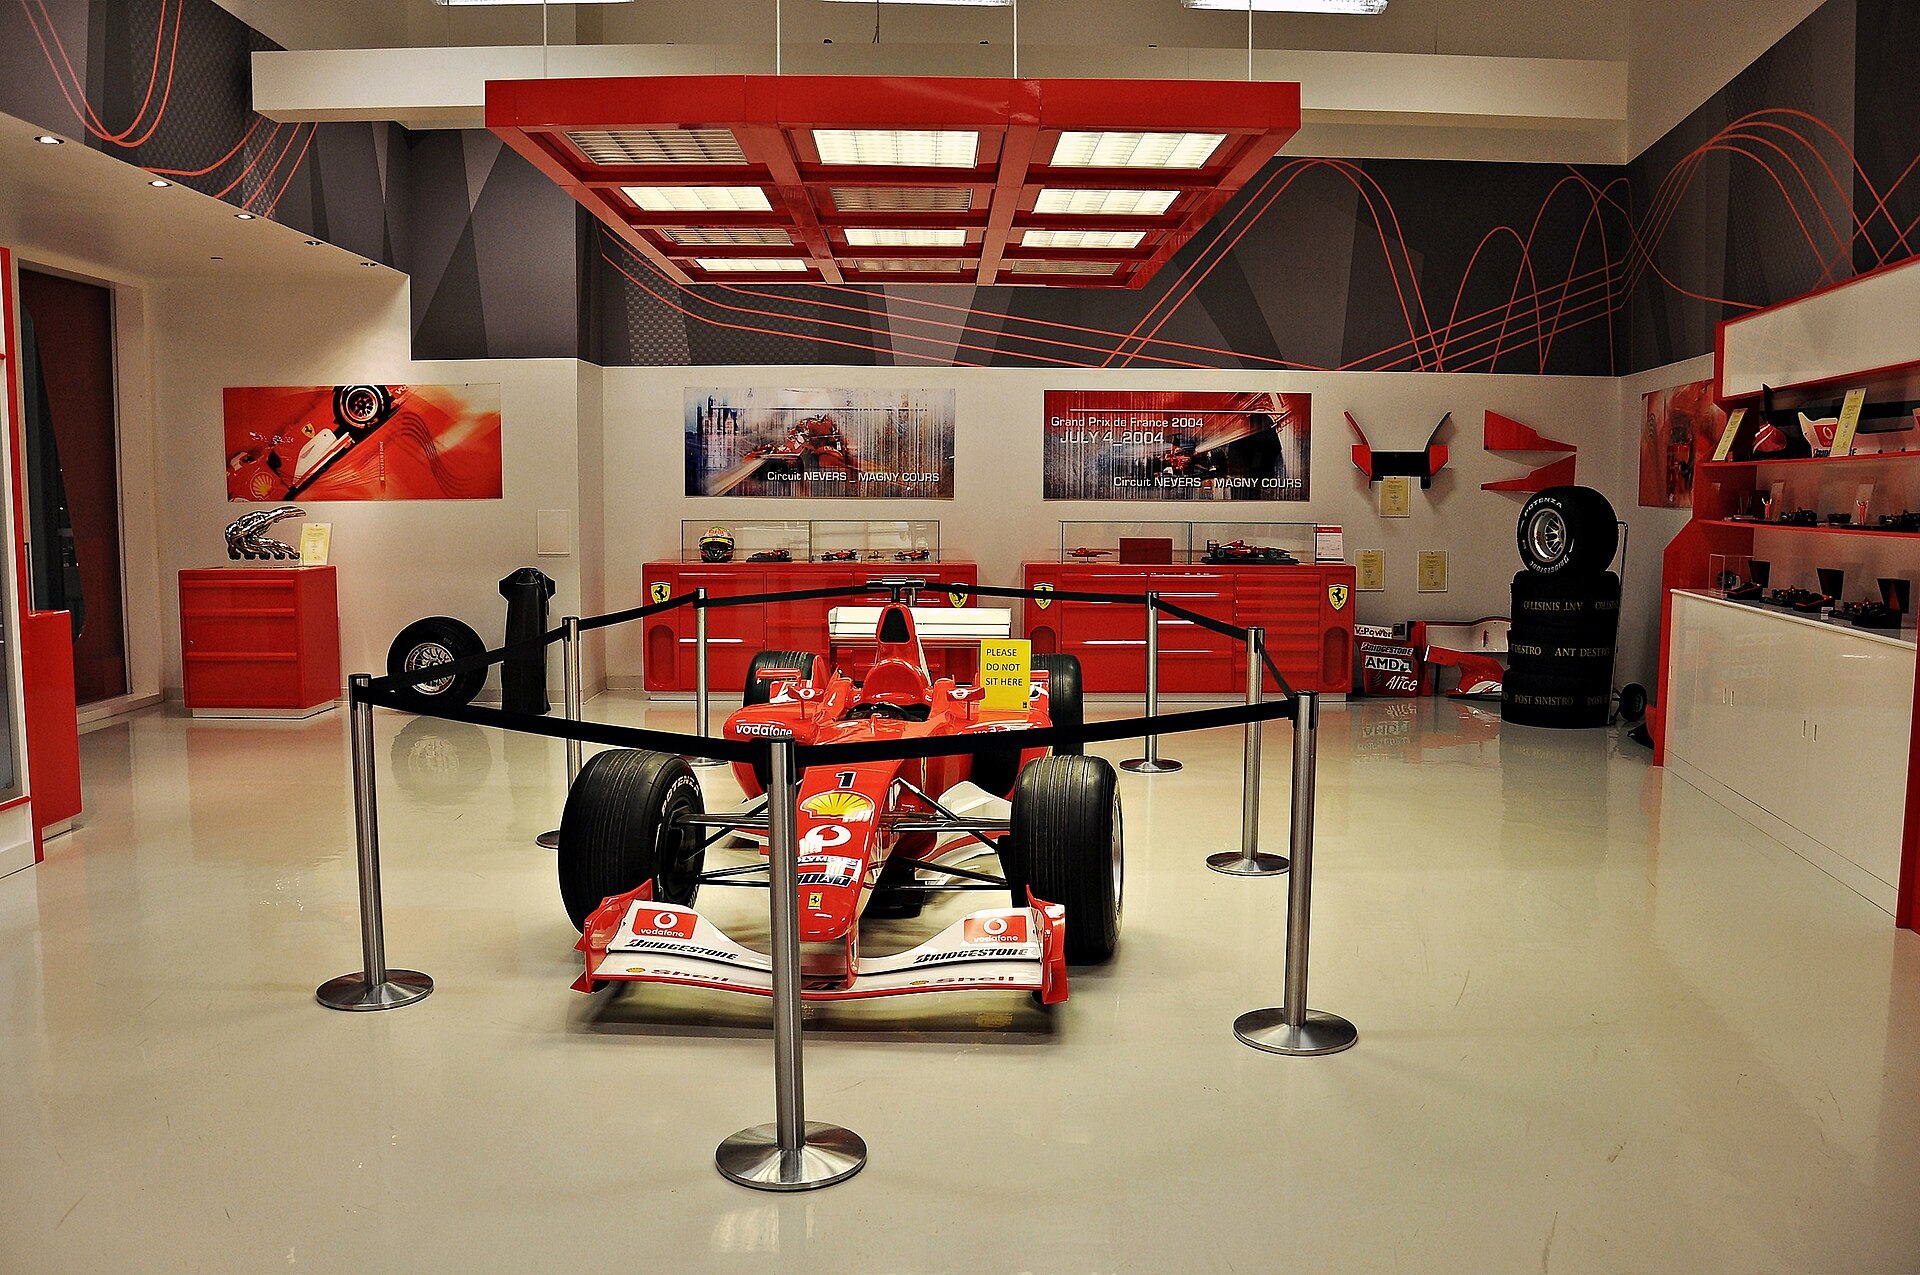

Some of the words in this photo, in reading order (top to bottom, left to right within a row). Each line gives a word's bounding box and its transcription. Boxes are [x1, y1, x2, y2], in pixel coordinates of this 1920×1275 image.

[1051, 416, 1085, 427] Grand
[1088, 417, 1111, 428] Prix
[1113, 418, 1127, 428] de
[1130, 418, 1169, 428] France
[1171, 418, 1204, 428] 2004
[1060, 431, 1101, 444] JULY
[766, 471, 802, 482] Circuit
[803, 471, 847, 482] NEVERS
[858, 472, 899, 482] MAGNY
[902, 472, 940, 483] COURS
[1113, 476, 1151, 488] Circuit
[1154, 476, 1202, 488] NEVERS
[1214, 477, 1259, 488] MAGNY
[1261, 477, 1302, 489] COURS
[1524, 497, 1563, 516] POTENZA
[1355, 626, 1393, 638] V-Power
[986, 648, 1017, 657] PLEASE
[1515, 644, 1542, 656] DESTRO
[1554, 647, 1579, 657] ANT
[1580, 647, 1610, 657] DESTRO
[986, 663, 1000, 671] DO
[1001, 663, 1021, 671] NOT
[1365, 656, 1400, 670] AMD
[985, 677, 998, 686] SIT
[1000, 678, 1023, 686] HERE
[1386, 675, 1418, 691] Alice
[1515, 695, 1533, 704] POST
[735, 724, 793, 737] vodafone
[835, 771, 857, 788] 1
[797, 873, 850, 886] IAT
[640, 928, 685, 937] vodafone
[973, 935, 1019, 943] vodafone
[624, 939, 739, 960] BRIDGESTONE
[913, 948, 1028, 964] BRIDGESTONE
